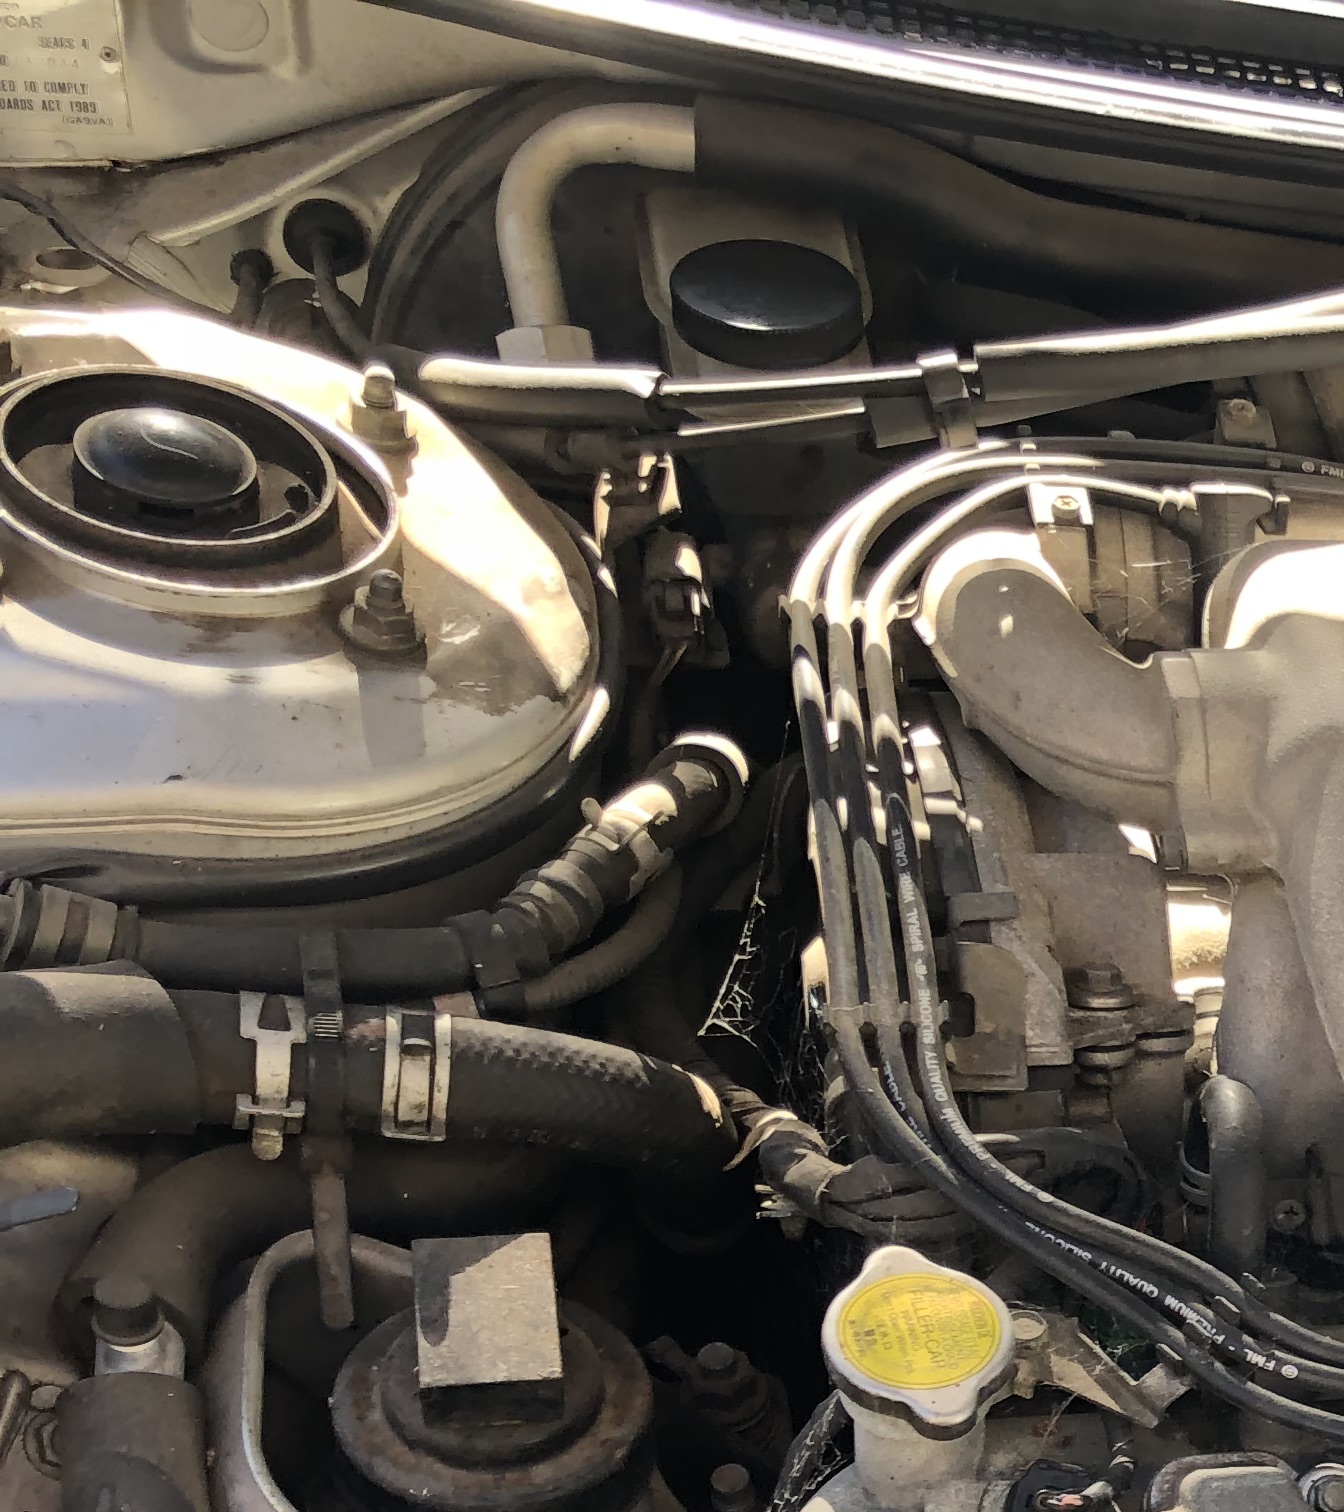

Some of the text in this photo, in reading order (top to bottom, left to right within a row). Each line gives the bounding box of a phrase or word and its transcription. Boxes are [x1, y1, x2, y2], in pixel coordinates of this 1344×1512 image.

[41, 100, 62, 113] ACT
[69, 101, 98, 114] 1989
[44, 82, 88, 95] COMPLY
[906, 908, 925, 953] SPIRAL
[917, 988, 937, 1046] SILICONE
[924, 1050, 949, 1102] QUALITY
[1101, 1261, 1159, 1299] QUALITY
